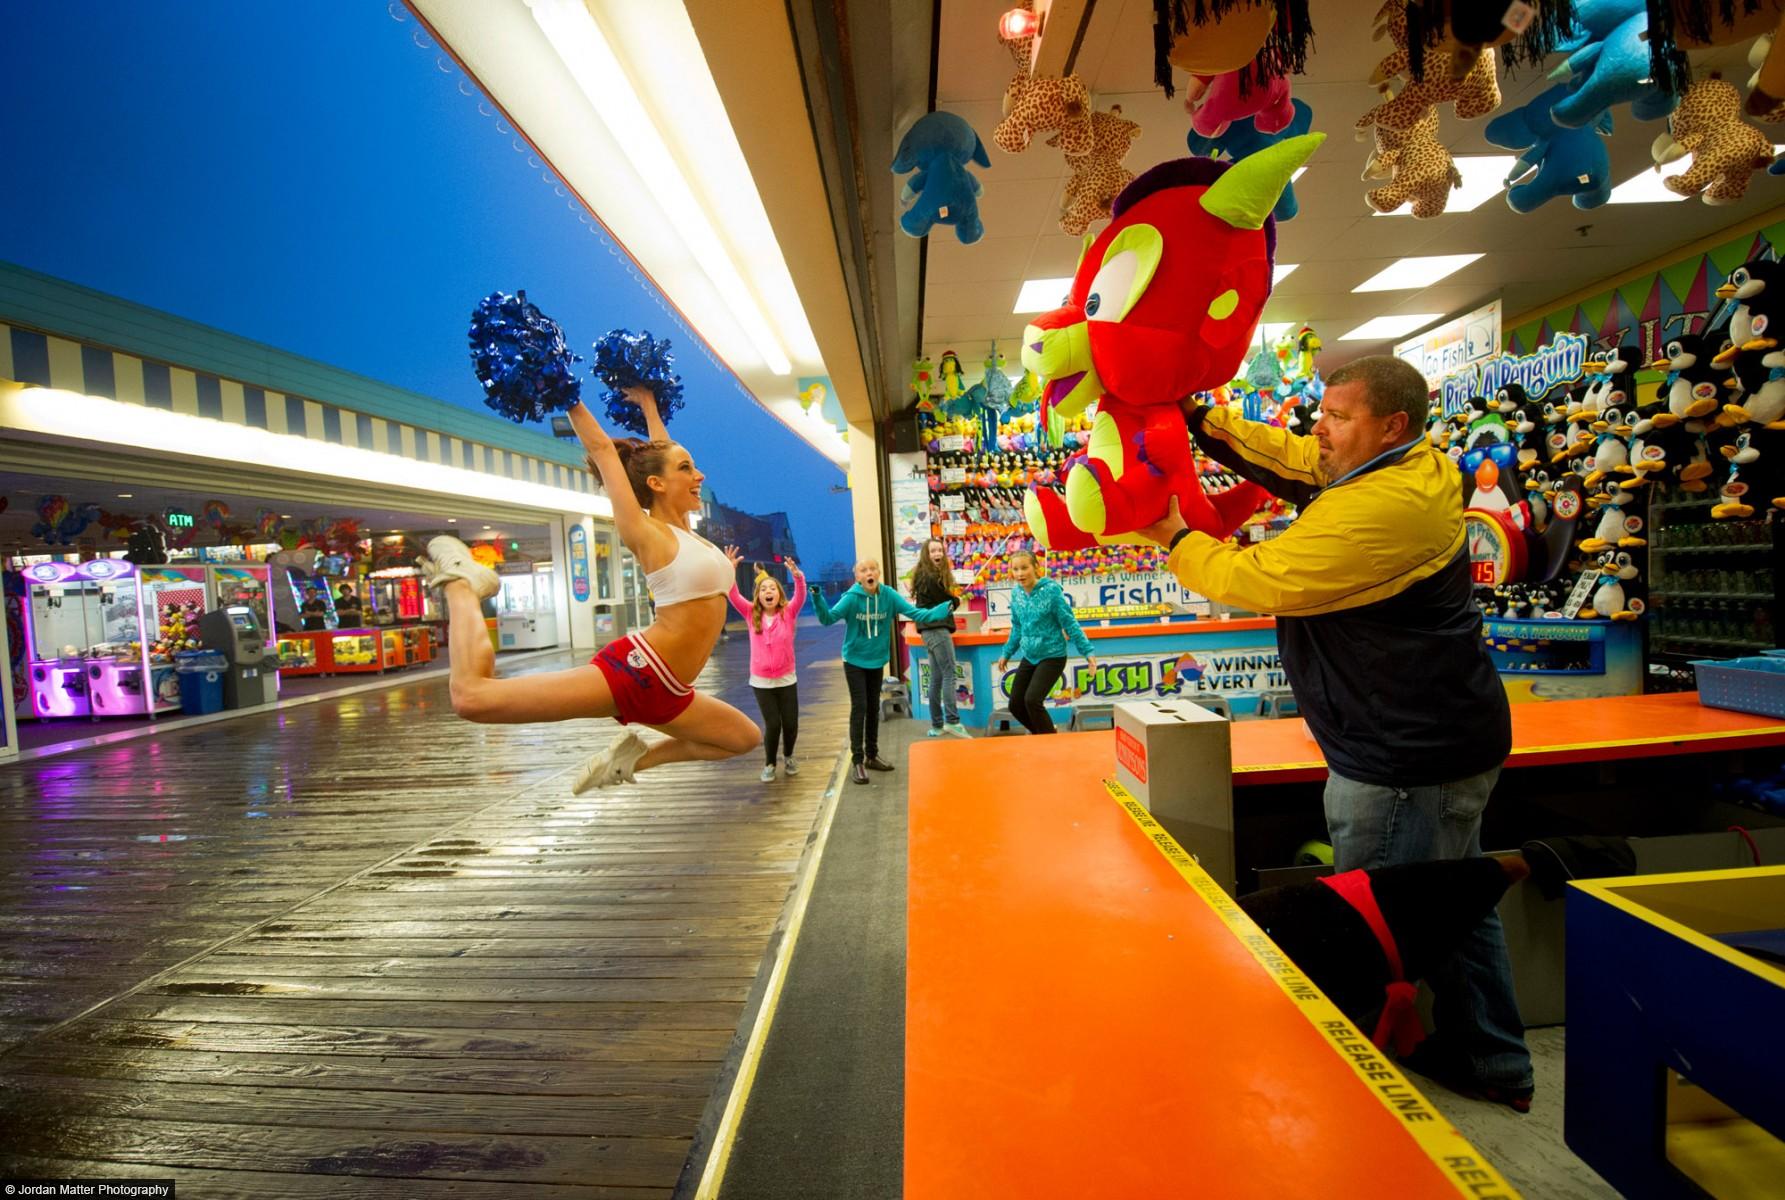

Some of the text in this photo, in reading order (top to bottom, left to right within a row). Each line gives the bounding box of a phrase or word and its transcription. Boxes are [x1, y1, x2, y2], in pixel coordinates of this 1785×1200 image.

[1442, 343, 1464, 370] Fish
[1443, 338, 1583, 418] Pick A Penguin
[169, 514, 193, 527] ATM
[1061, 575, 1087, 586] Fish
[1091, 575, 1103, 584] Is
[1107, 574, 1116, 583] A
[1212, 654, 1282, 672] WINNE
[1076, 663, 1150, 696] FISH
[1197, 671, 1288, 691] EVERY TI
[1243, 934, 1320, 1002] RELEASE LINE
[1320, 1019, 1435, 1123] RELEASE LINE
